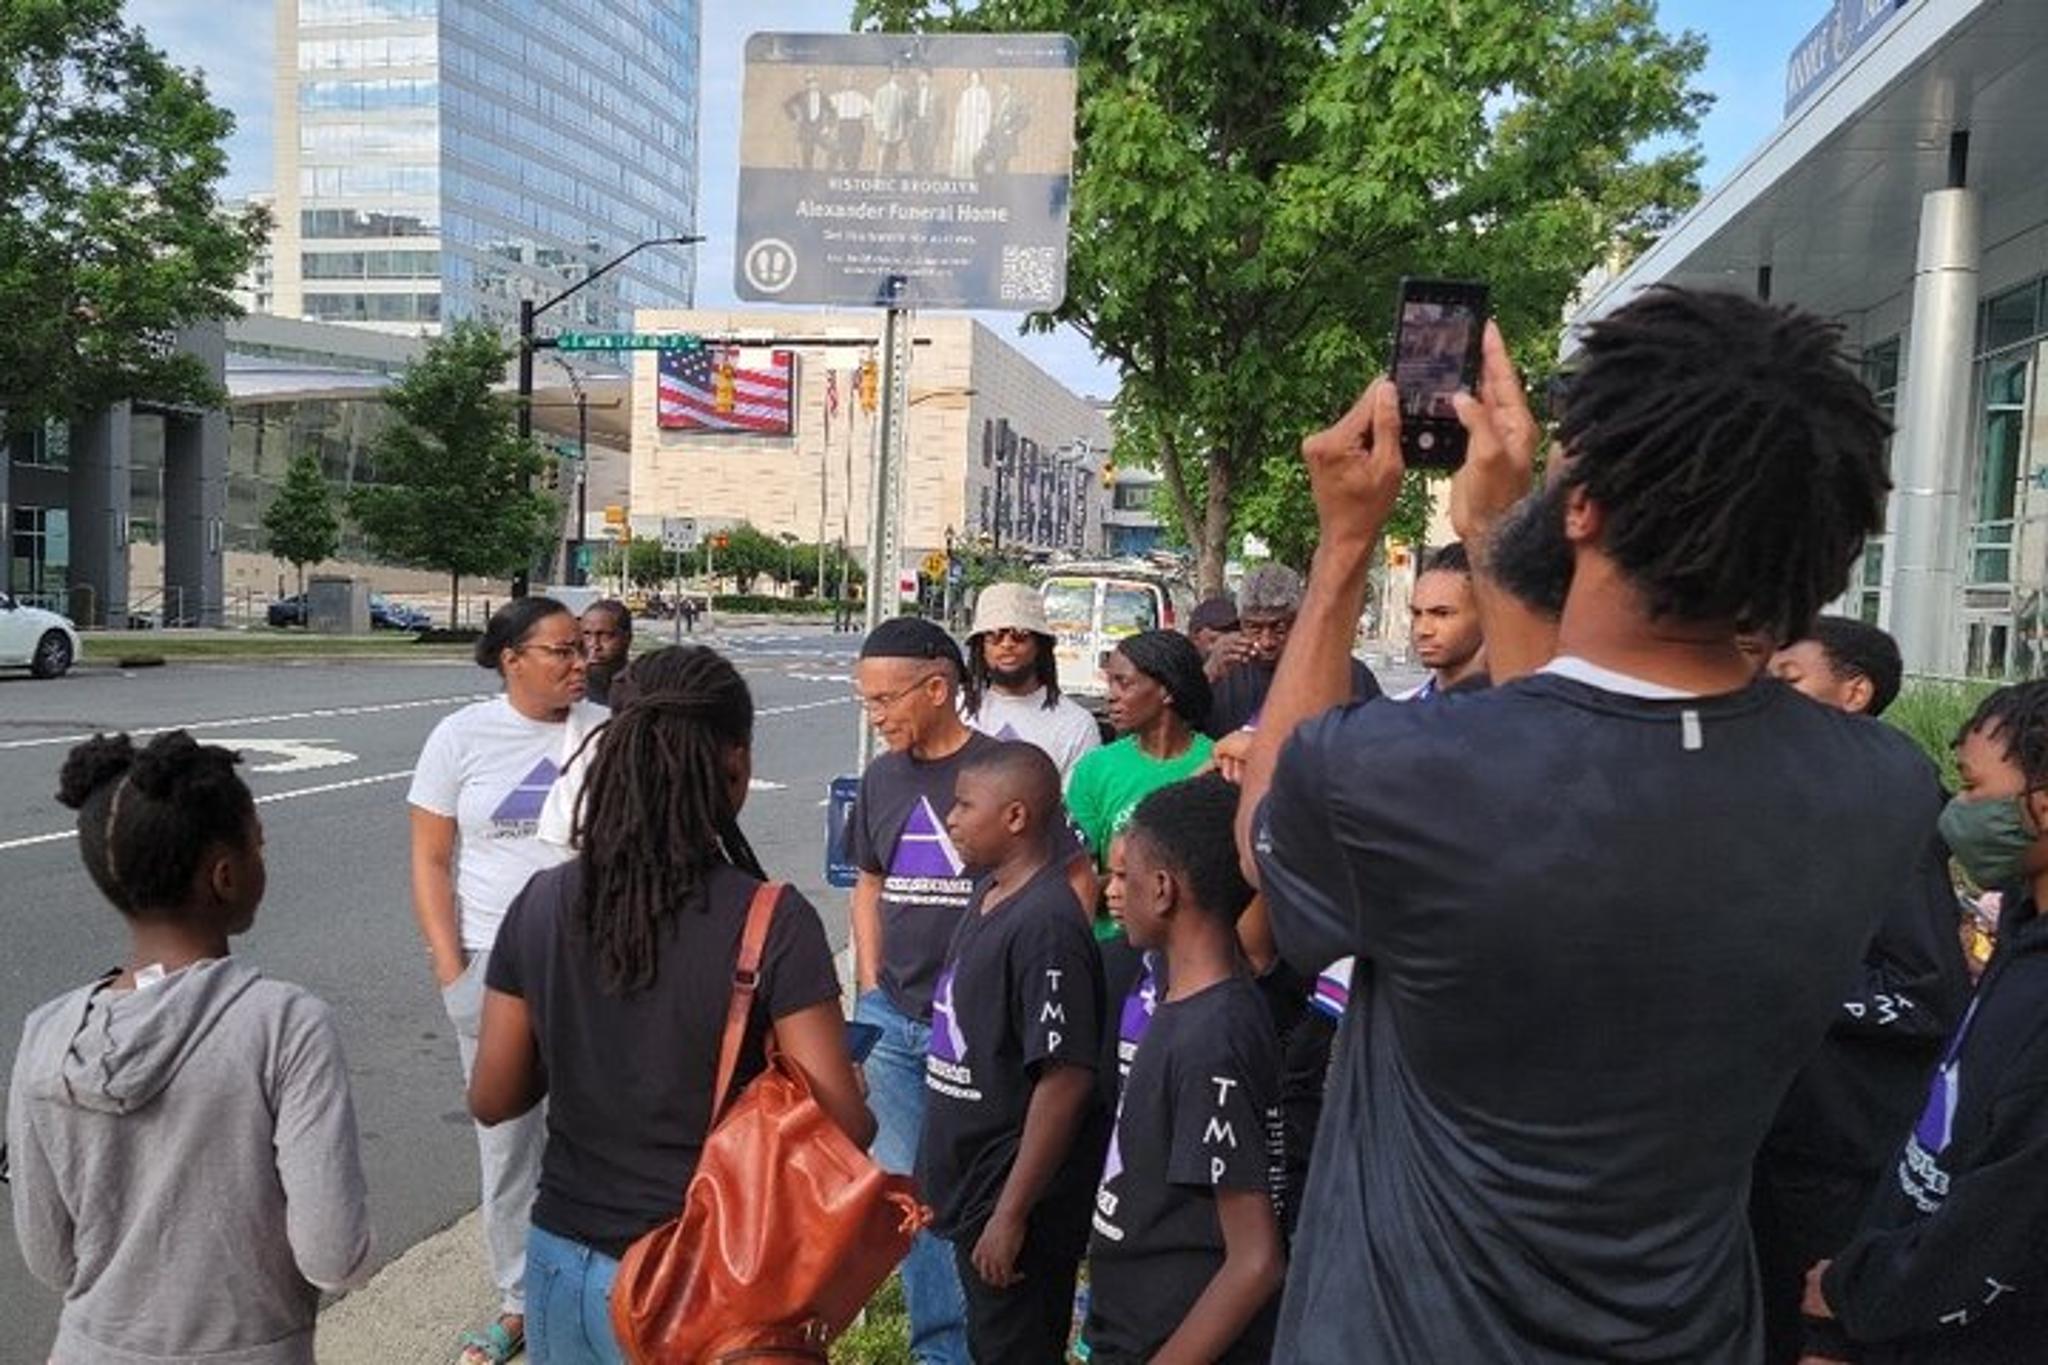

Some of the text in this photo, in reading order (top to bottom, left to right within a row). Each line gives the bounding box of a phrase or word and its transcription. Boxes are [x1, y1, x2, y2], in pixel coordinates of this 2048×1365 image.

[828, 178, 896, 193] HISTORIC
[796, 200, 1009, 223] Alexander Funeral Home
